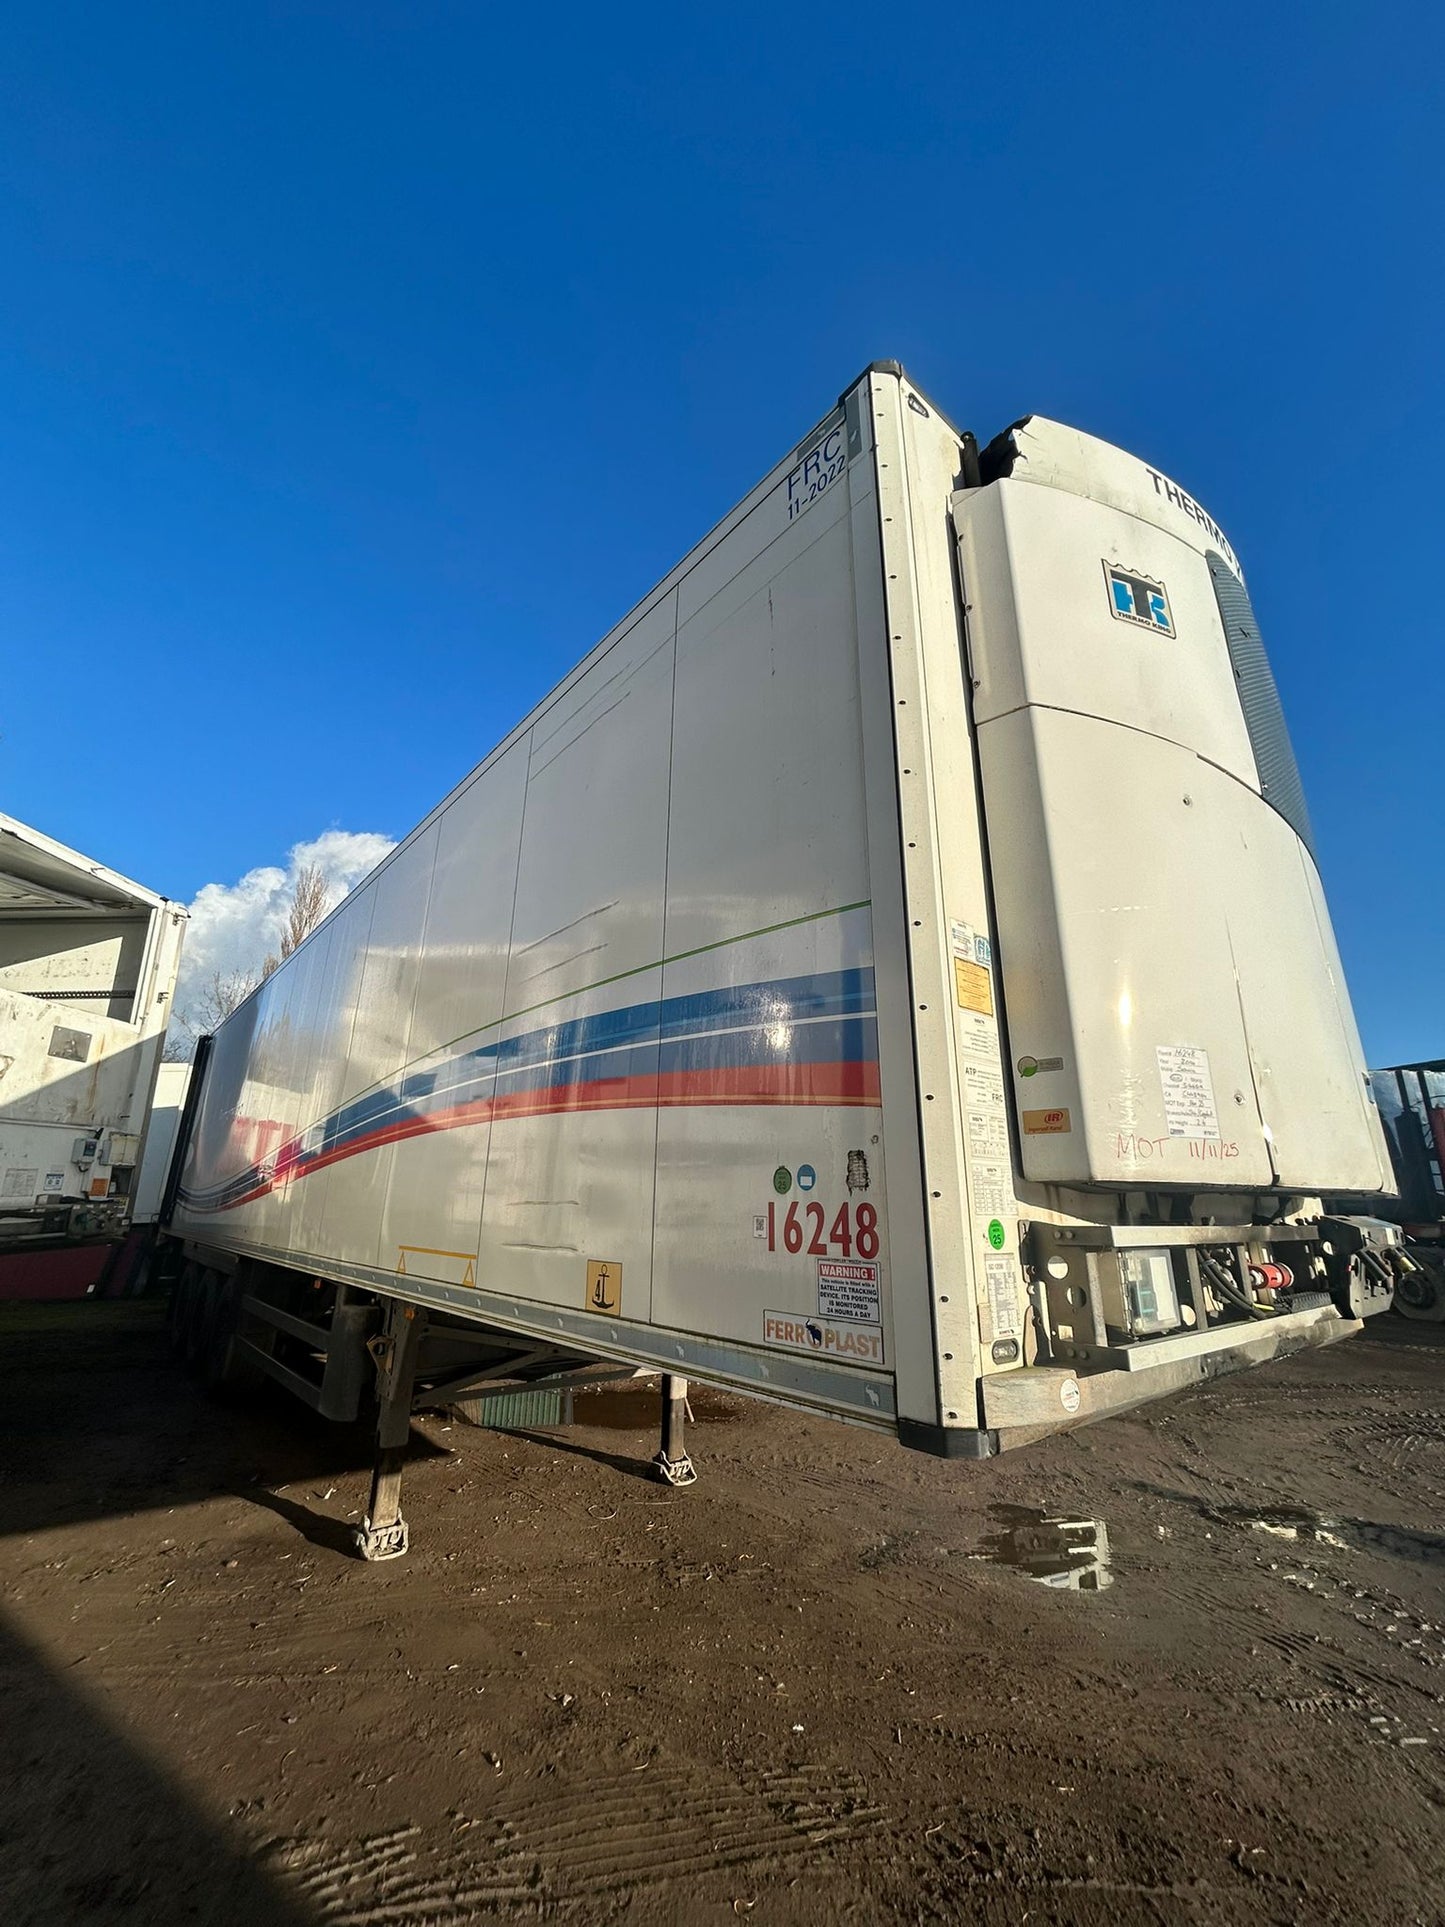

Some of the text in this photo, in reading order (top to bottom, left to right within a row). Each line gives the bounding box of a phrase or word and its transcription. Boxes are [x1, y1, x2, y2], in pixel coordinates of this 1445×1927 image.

[788, 431, 842, 501] FRC
[787, 455, 846, 520] 11-2022
[1145, 467, 1233, 563] THERMO
[1117, 611, 1172, 634] THERMO KING
[1117, 1134, 1239, 1160] MOT 11/11/25
[768, 1201, 880, 1260] 16248
[992, 1234, 1002, 1245] 25
[820, 1264, 875, 1280] WARNING !
[820, 1284, 877, 1295] SATELLITE TRACKING
[836, 1301, 868, 1310] MONITORED
[851, 1295, 879, 1304] POSITION
[835, 1309, 853, 1317] HOURS
